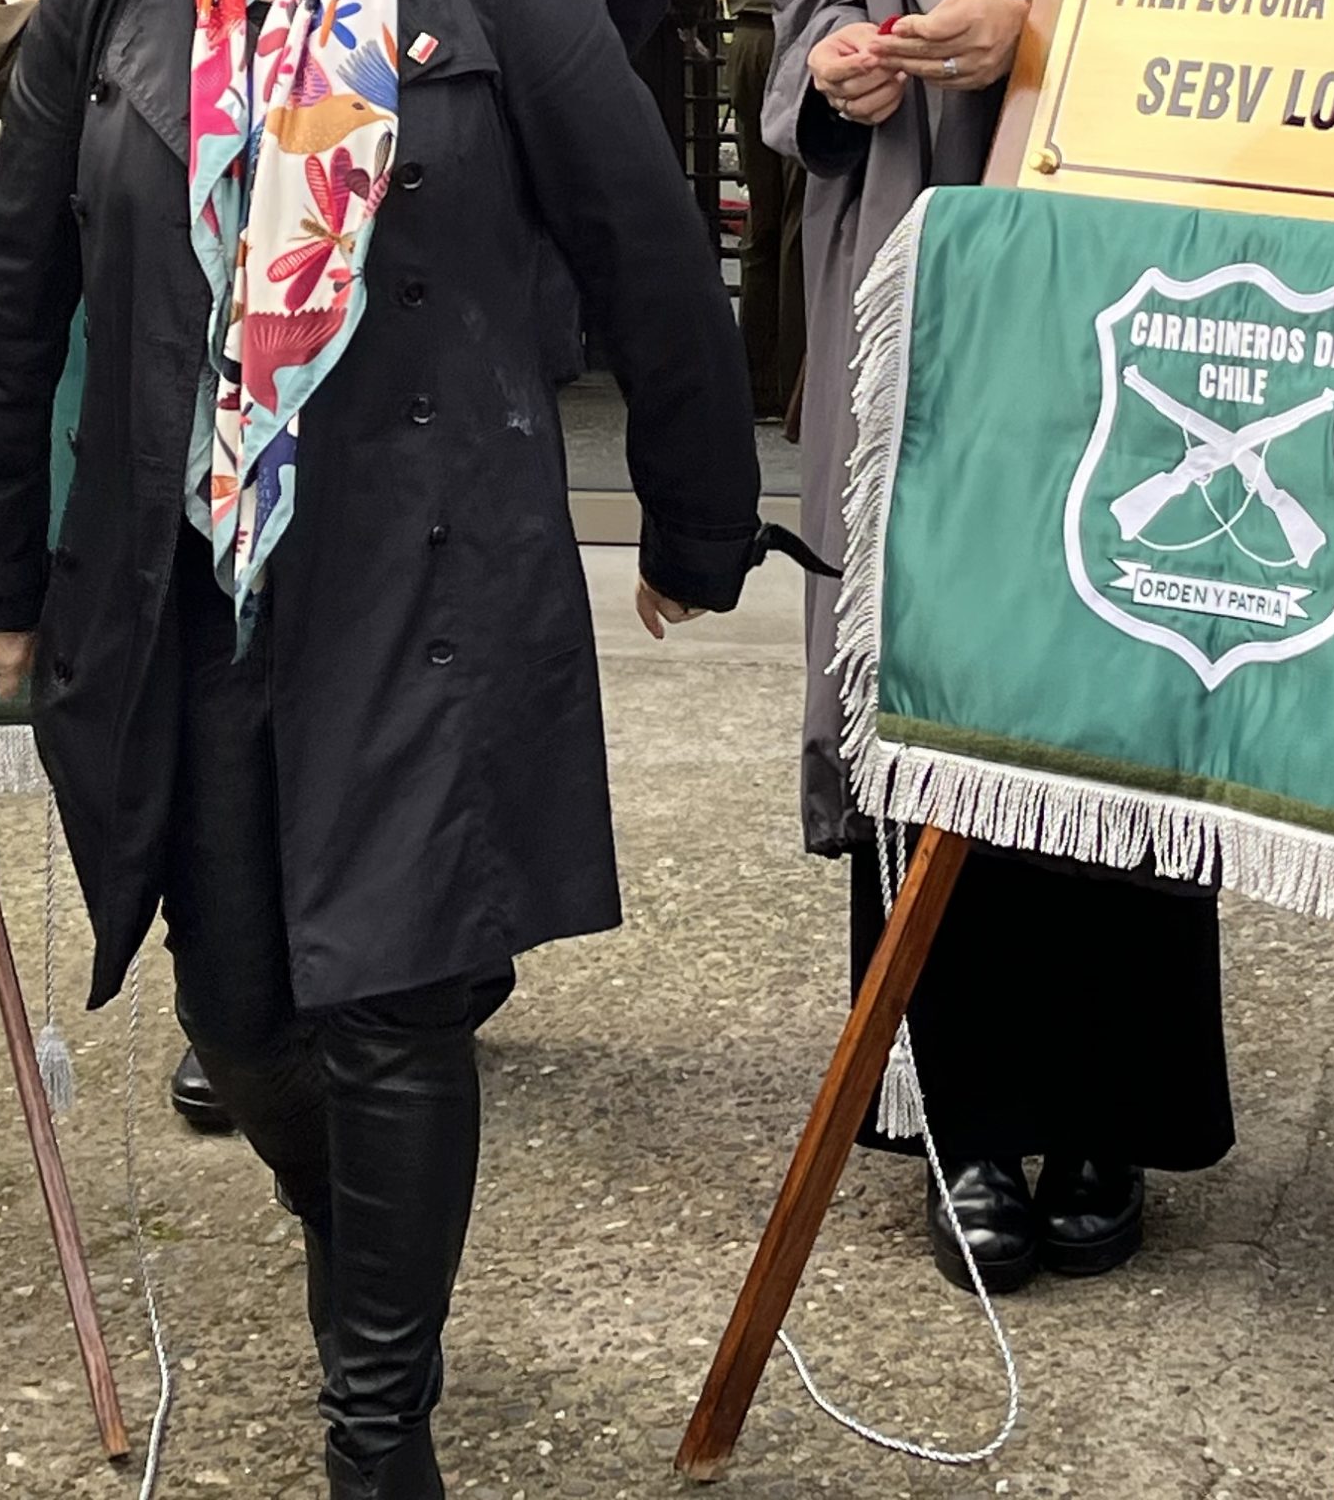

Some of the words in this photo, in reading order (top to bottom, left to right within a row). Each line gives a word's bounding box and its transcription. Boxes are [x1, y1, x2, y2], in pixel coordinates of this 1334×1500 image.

[1137, 57, 1272, 123] SEBV
[1130, 312, 1305, 363] CARABINEROS
[1198, 364, 1268, 405] CHILE
[1139, 578, 1207, 605] ORDEN
[1212, 588, 1226, 606] Y
[1228, 591, 1283, 618] PATRIA
